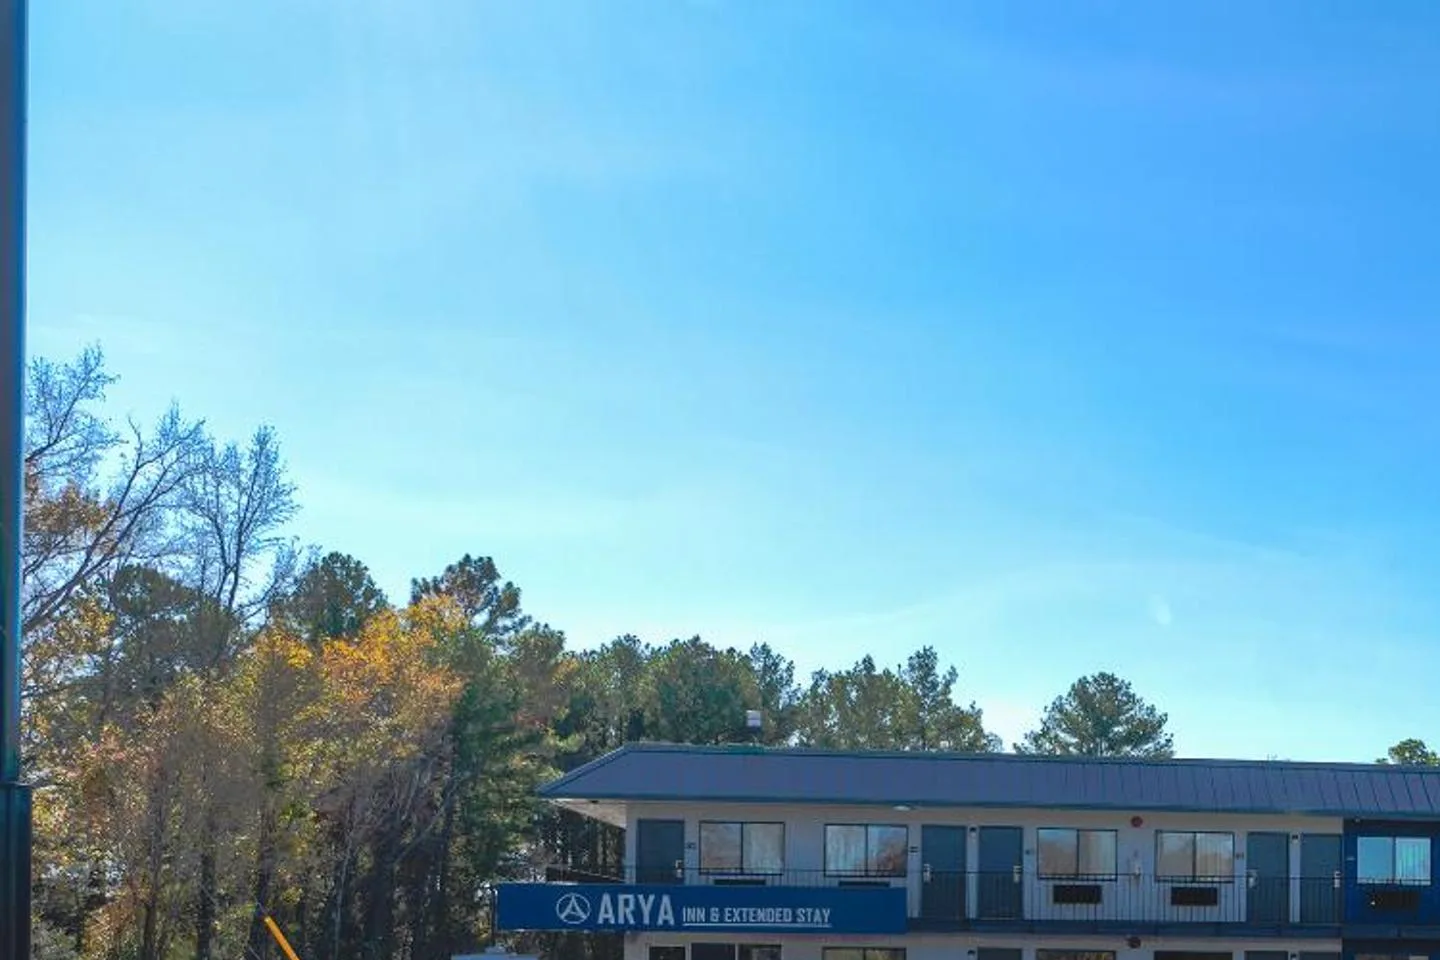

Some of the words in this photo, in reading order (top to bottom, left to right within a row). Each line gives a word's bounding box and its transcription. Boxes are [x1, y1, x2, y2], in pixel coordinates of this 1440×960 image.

[598, 893, 675, 926] ARYA
[683, 907, 706, 923] INN
[710, 907, 720, 923] &
[725, 907, 793, 923] EXTENDED
[797, 907, 831, 924] STAY
